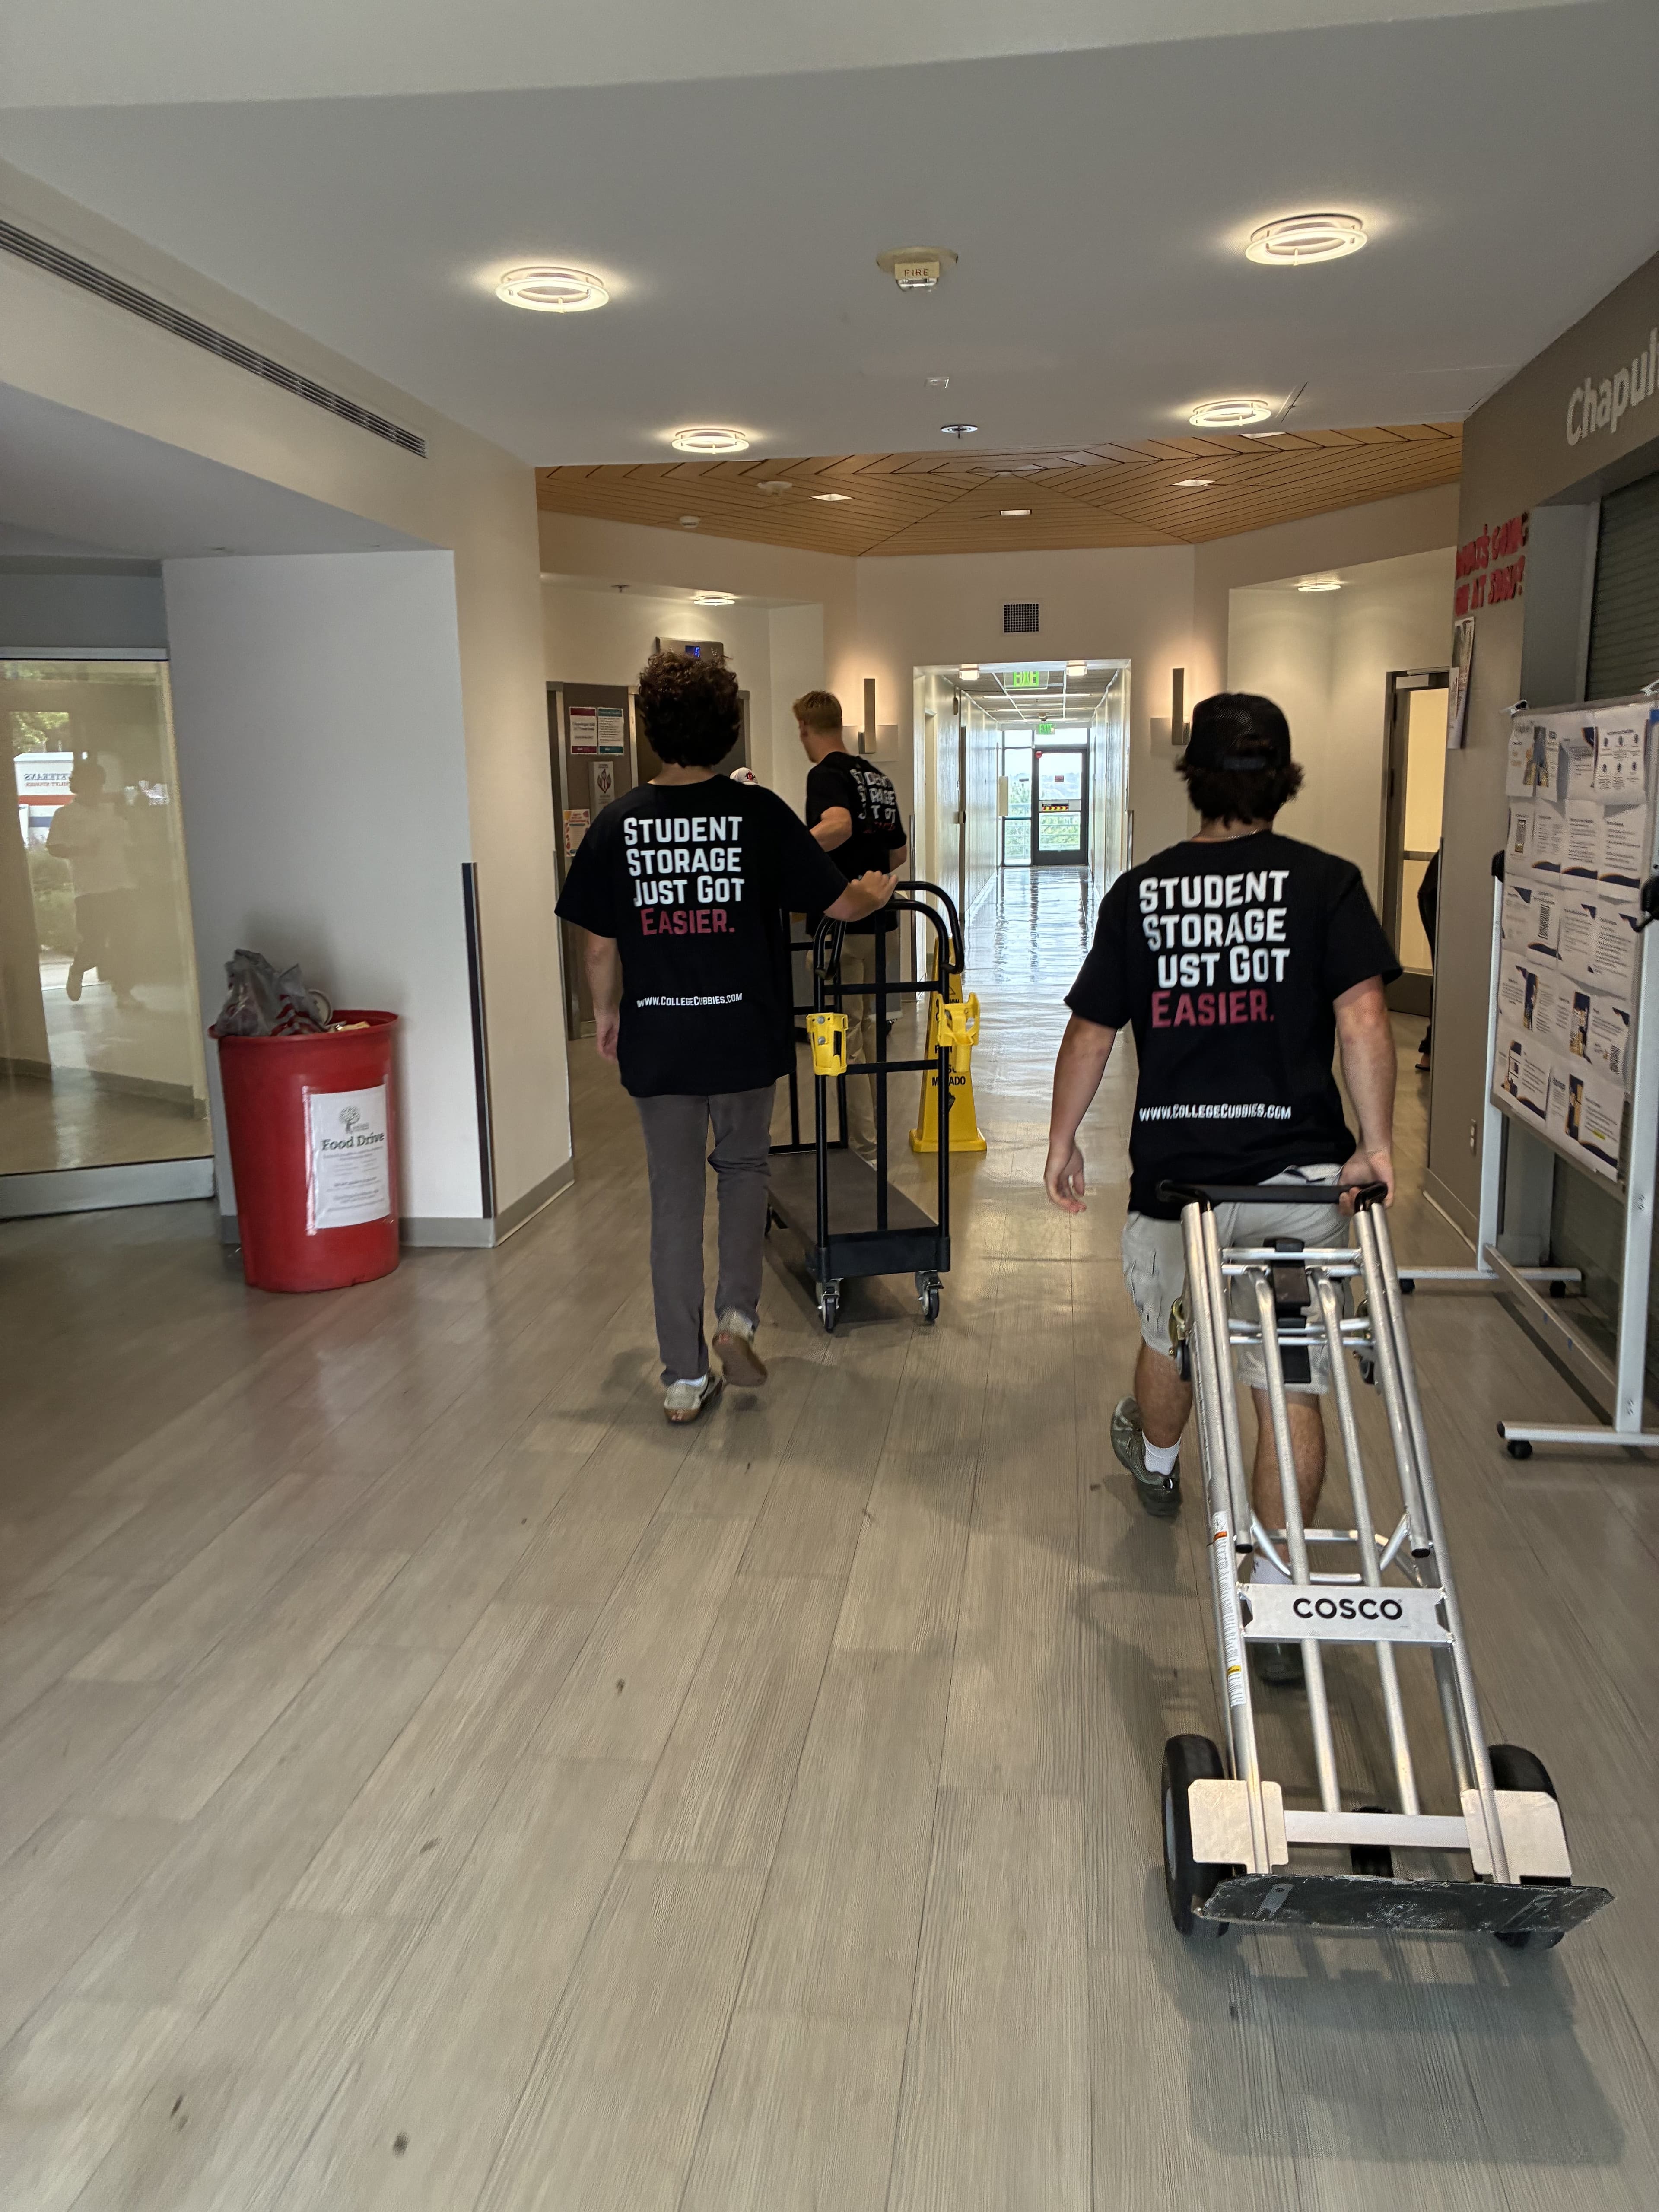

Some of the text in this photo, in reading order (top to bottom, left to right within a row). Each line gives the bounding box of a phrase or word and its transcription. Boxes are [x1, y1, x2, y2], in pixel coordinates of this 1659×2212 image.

[904, 268, 929, 276] FIRE
[1566, 327, 1659, 446] Chapul
[1039, 723, 1053, 734] EXIT
[623, 816, 743, 845] STUDENT
[626, 847, 742, 876] STORAGE
[633, 875, 745, 907] JUST GOT
[1139, 870, 1290, 914] STUDENT
[641, 908, 735, 936] EASIER.
[1142, 907, 1287, 951] STORAGE
[1158, 945, 1290, 988] UST GOT
[1152, 989, 1274, 1028] EASIER.
[932, 1076, 966, 1086] MADO
[321, 1131, 384, 1151] Food Drive
[1293, 1598, 1402, 1620] COSCO
